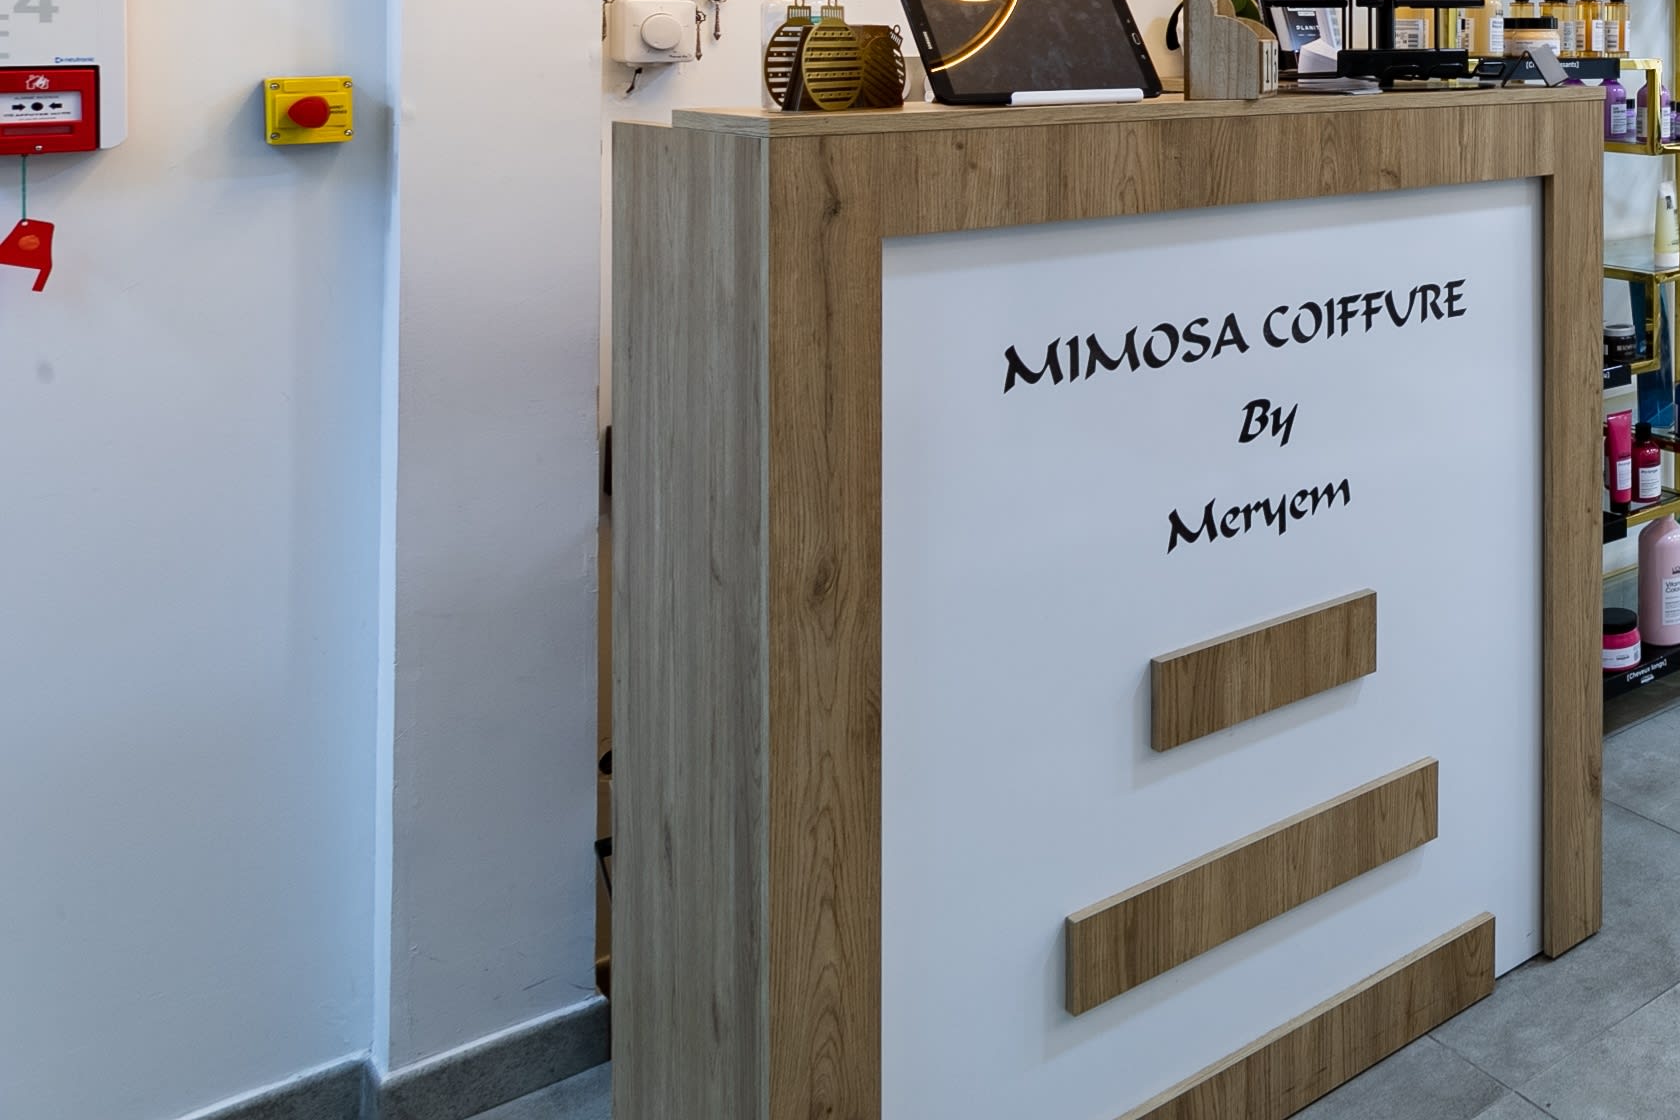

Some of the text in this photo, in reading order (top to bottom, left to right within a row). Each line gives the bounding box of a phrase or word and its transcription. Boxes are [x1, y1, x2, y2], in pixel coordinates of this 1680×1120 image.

[1003, 278, 1468, 394] MIMOSA COIFFURE
[1238, 398, 1298, 447] By
[1166, 477, 1352, 554] Meryem
